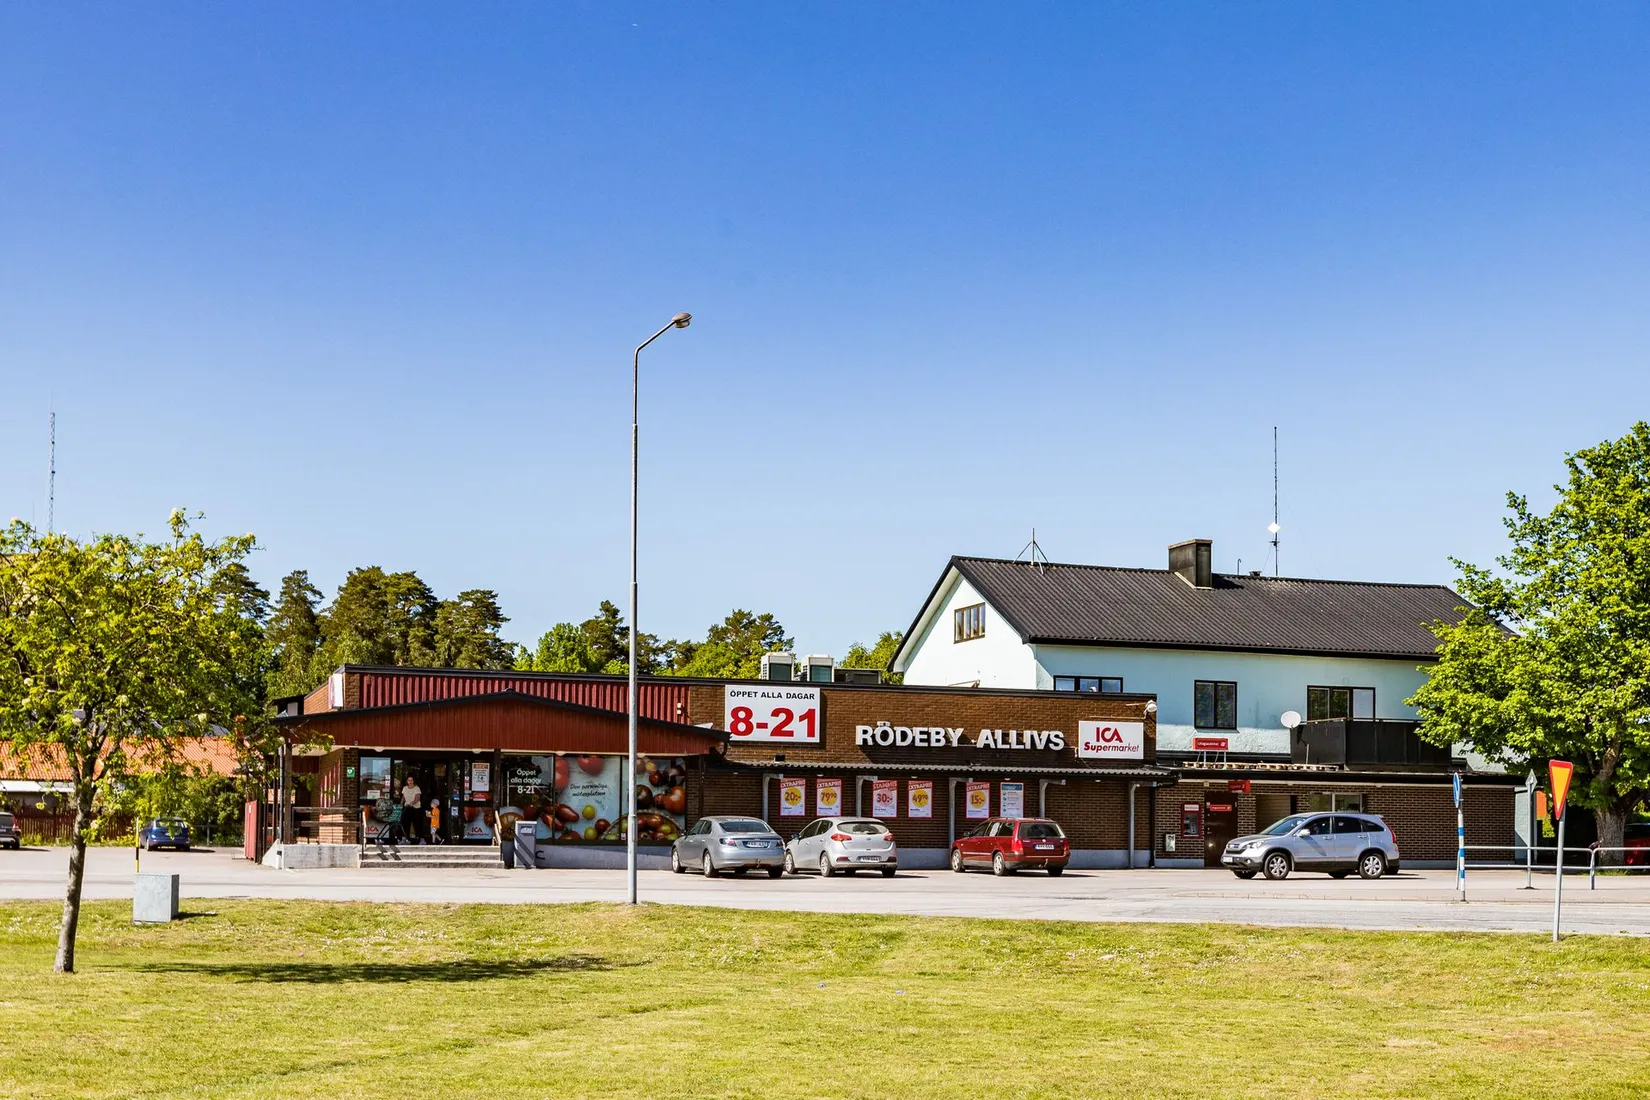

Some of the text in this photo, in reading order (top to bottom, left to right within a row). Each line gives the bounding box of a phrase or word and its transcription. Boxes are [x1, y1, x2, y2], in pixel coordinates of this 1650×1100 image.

[729, 689, 815, 700] ÖPPET ALLA DAGAR
[729, 706, 816, 738] 8-21
[855, 721, 1065, 751] RÖDEBY ALLIVS
[1095, 727, 1124, 743] ICA
[1083, 741, 1140, 753] Supermarket
[516, 768, 537, 777] Öppet
[517, 785, 536, 794] 8-21
